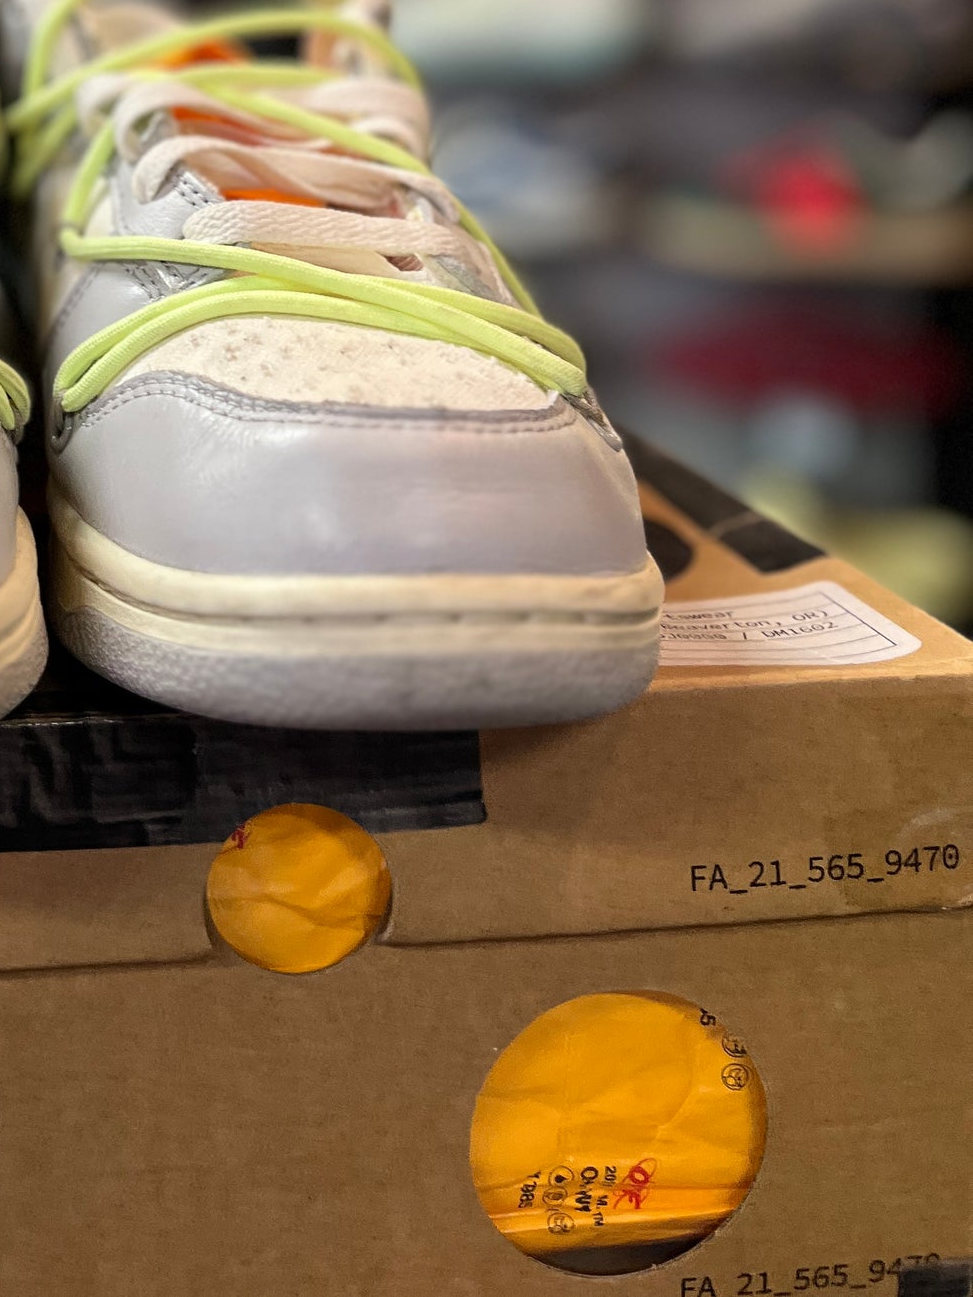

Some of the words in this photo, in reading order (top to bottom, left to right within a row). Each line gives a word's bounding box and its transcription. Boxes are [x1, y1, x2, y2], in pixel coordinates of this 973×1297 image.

[791, 610, 828, 622] OR)
[761, 621, 839, 639] DM1602
[690, 844, 960, 895] FA_21_565_9470
